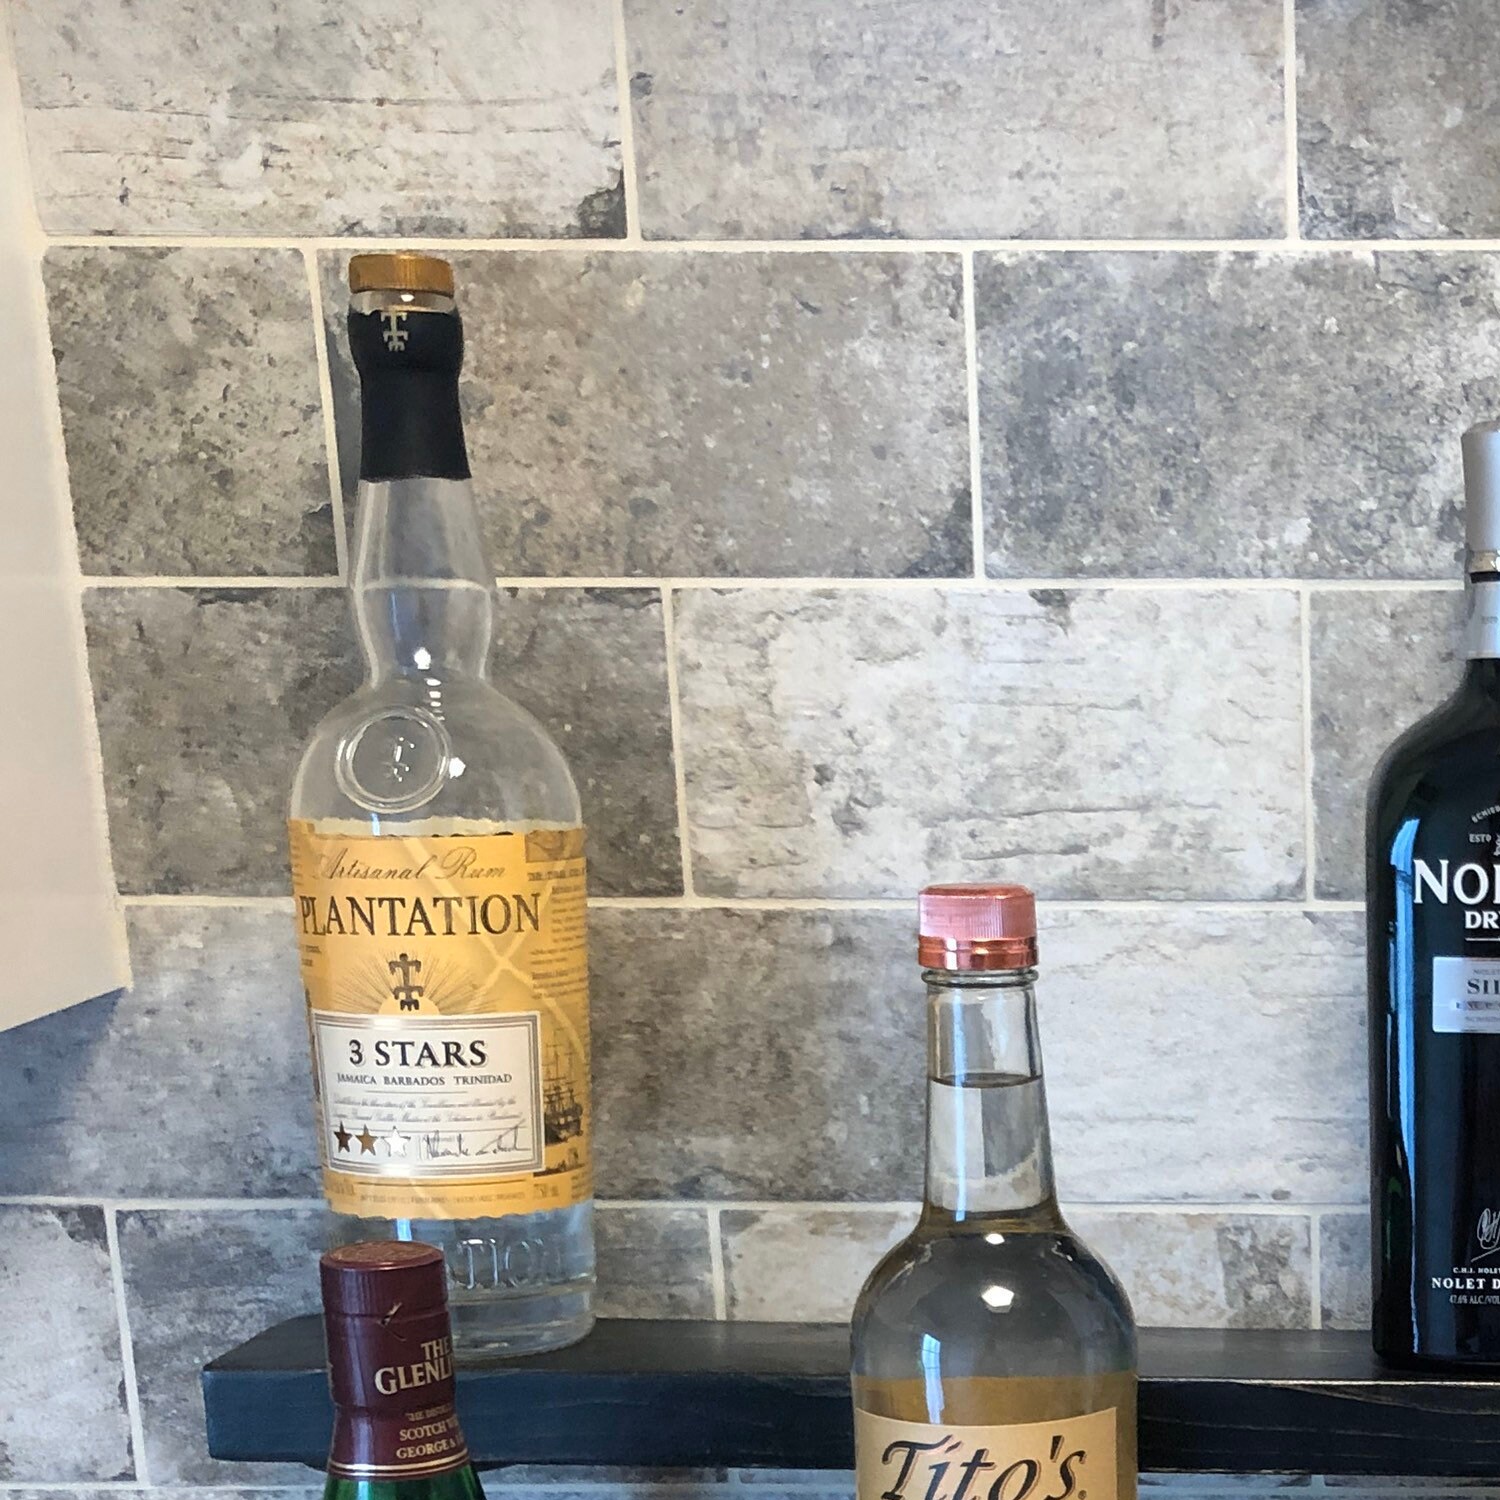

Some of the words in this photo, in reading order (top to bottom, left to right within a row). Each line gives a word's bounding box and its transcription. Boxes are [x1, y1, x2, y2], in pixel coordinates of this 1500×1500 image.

[311, 846, 426, 881] Artisanal
[435, 846, 506, 880] Rum
[301, 892, 542, 937] PLANTATION
[349, 1040, 365, 1066] 3
[375, 1040, 488, 1067] STARS
[338, 1073, 377, 1085] JAMAICA
[383, 1076, 445, 1086] BARBADOS
[454, 1074, 513, 1085] TRINIDAD
[1431, 1277, 1486, 1290] NOLET
[421, 1336, 452, 1361] THE
[399, 1420, 447, 1442] SCOTCH
[396, 1438, 450, 1460] GEORGE
